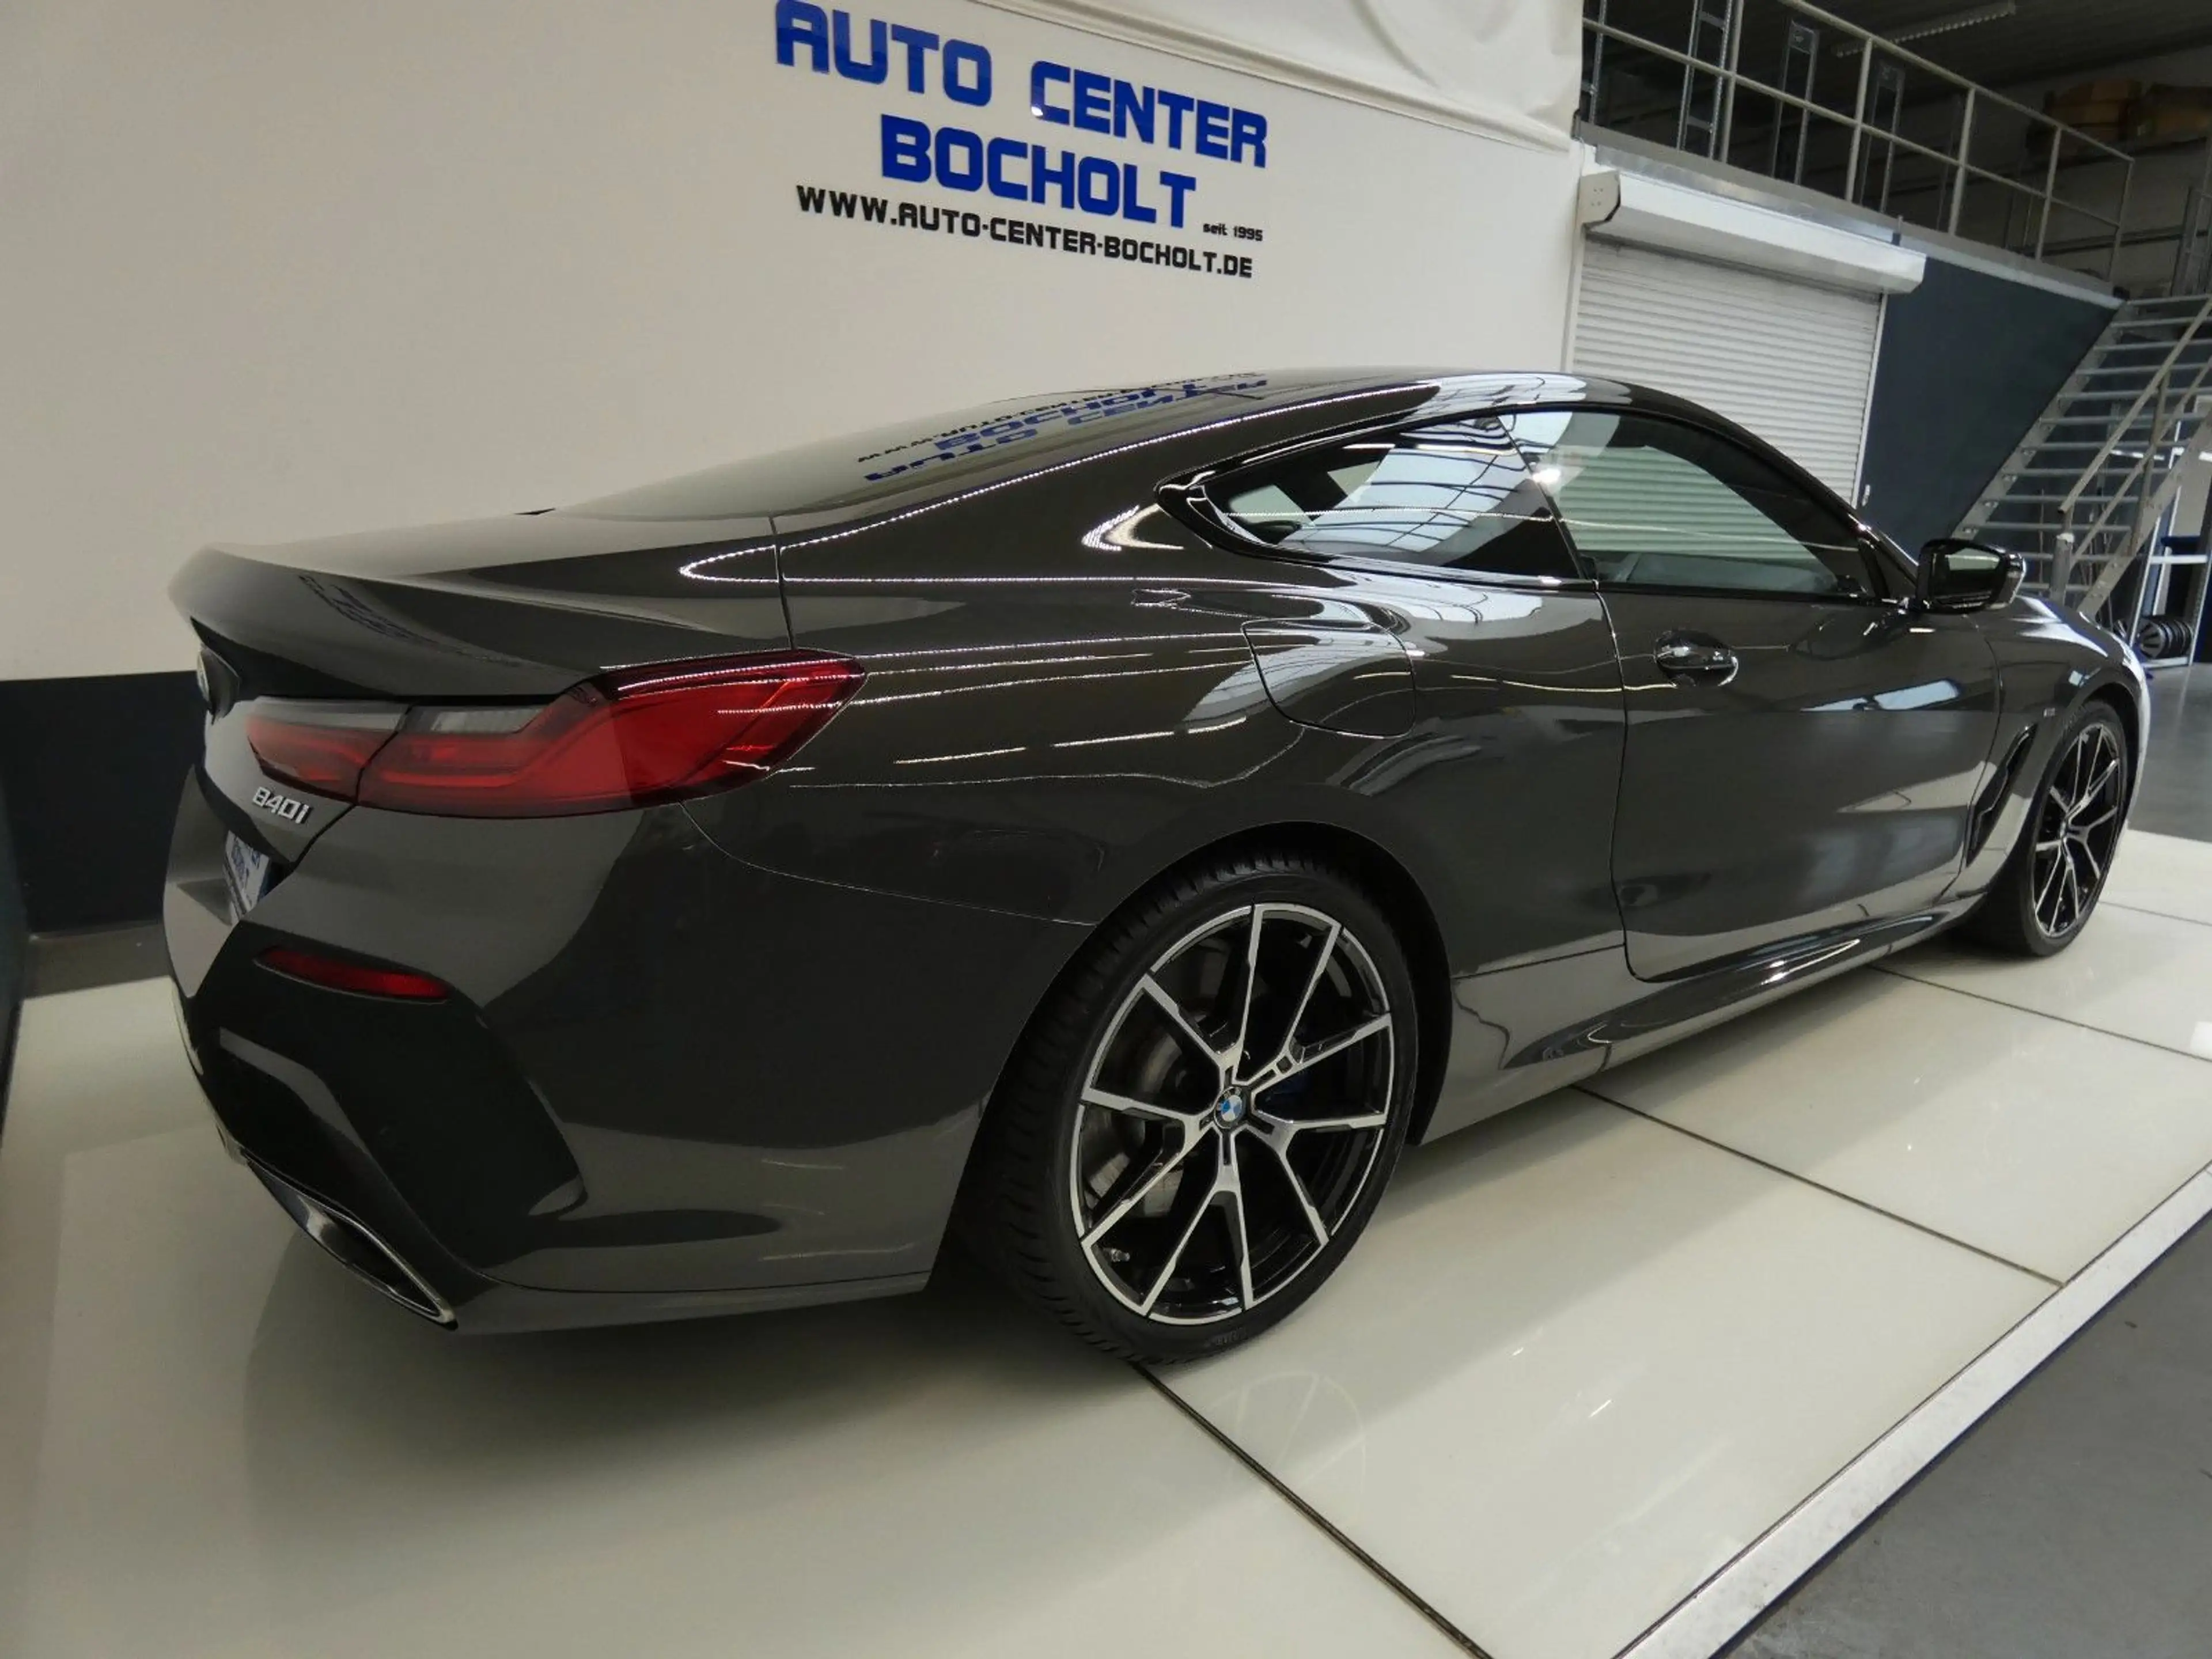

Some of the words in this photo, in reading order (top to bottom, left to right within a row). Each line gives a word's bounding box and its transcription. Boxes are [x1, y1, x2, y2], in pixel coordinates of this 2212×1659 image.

[777, 0, 992, 107] AUTO
[1031, 61, 1267, 167] CENTER
[881, 115, 1196, 228] BOCHOLT
[796, 185, 1252, 278] WWW.AUTO-CENTER-BOCHOLT.DE
[1203, 223, 1228, 236] seit
[1233, 226, 1263, 241] 1995
